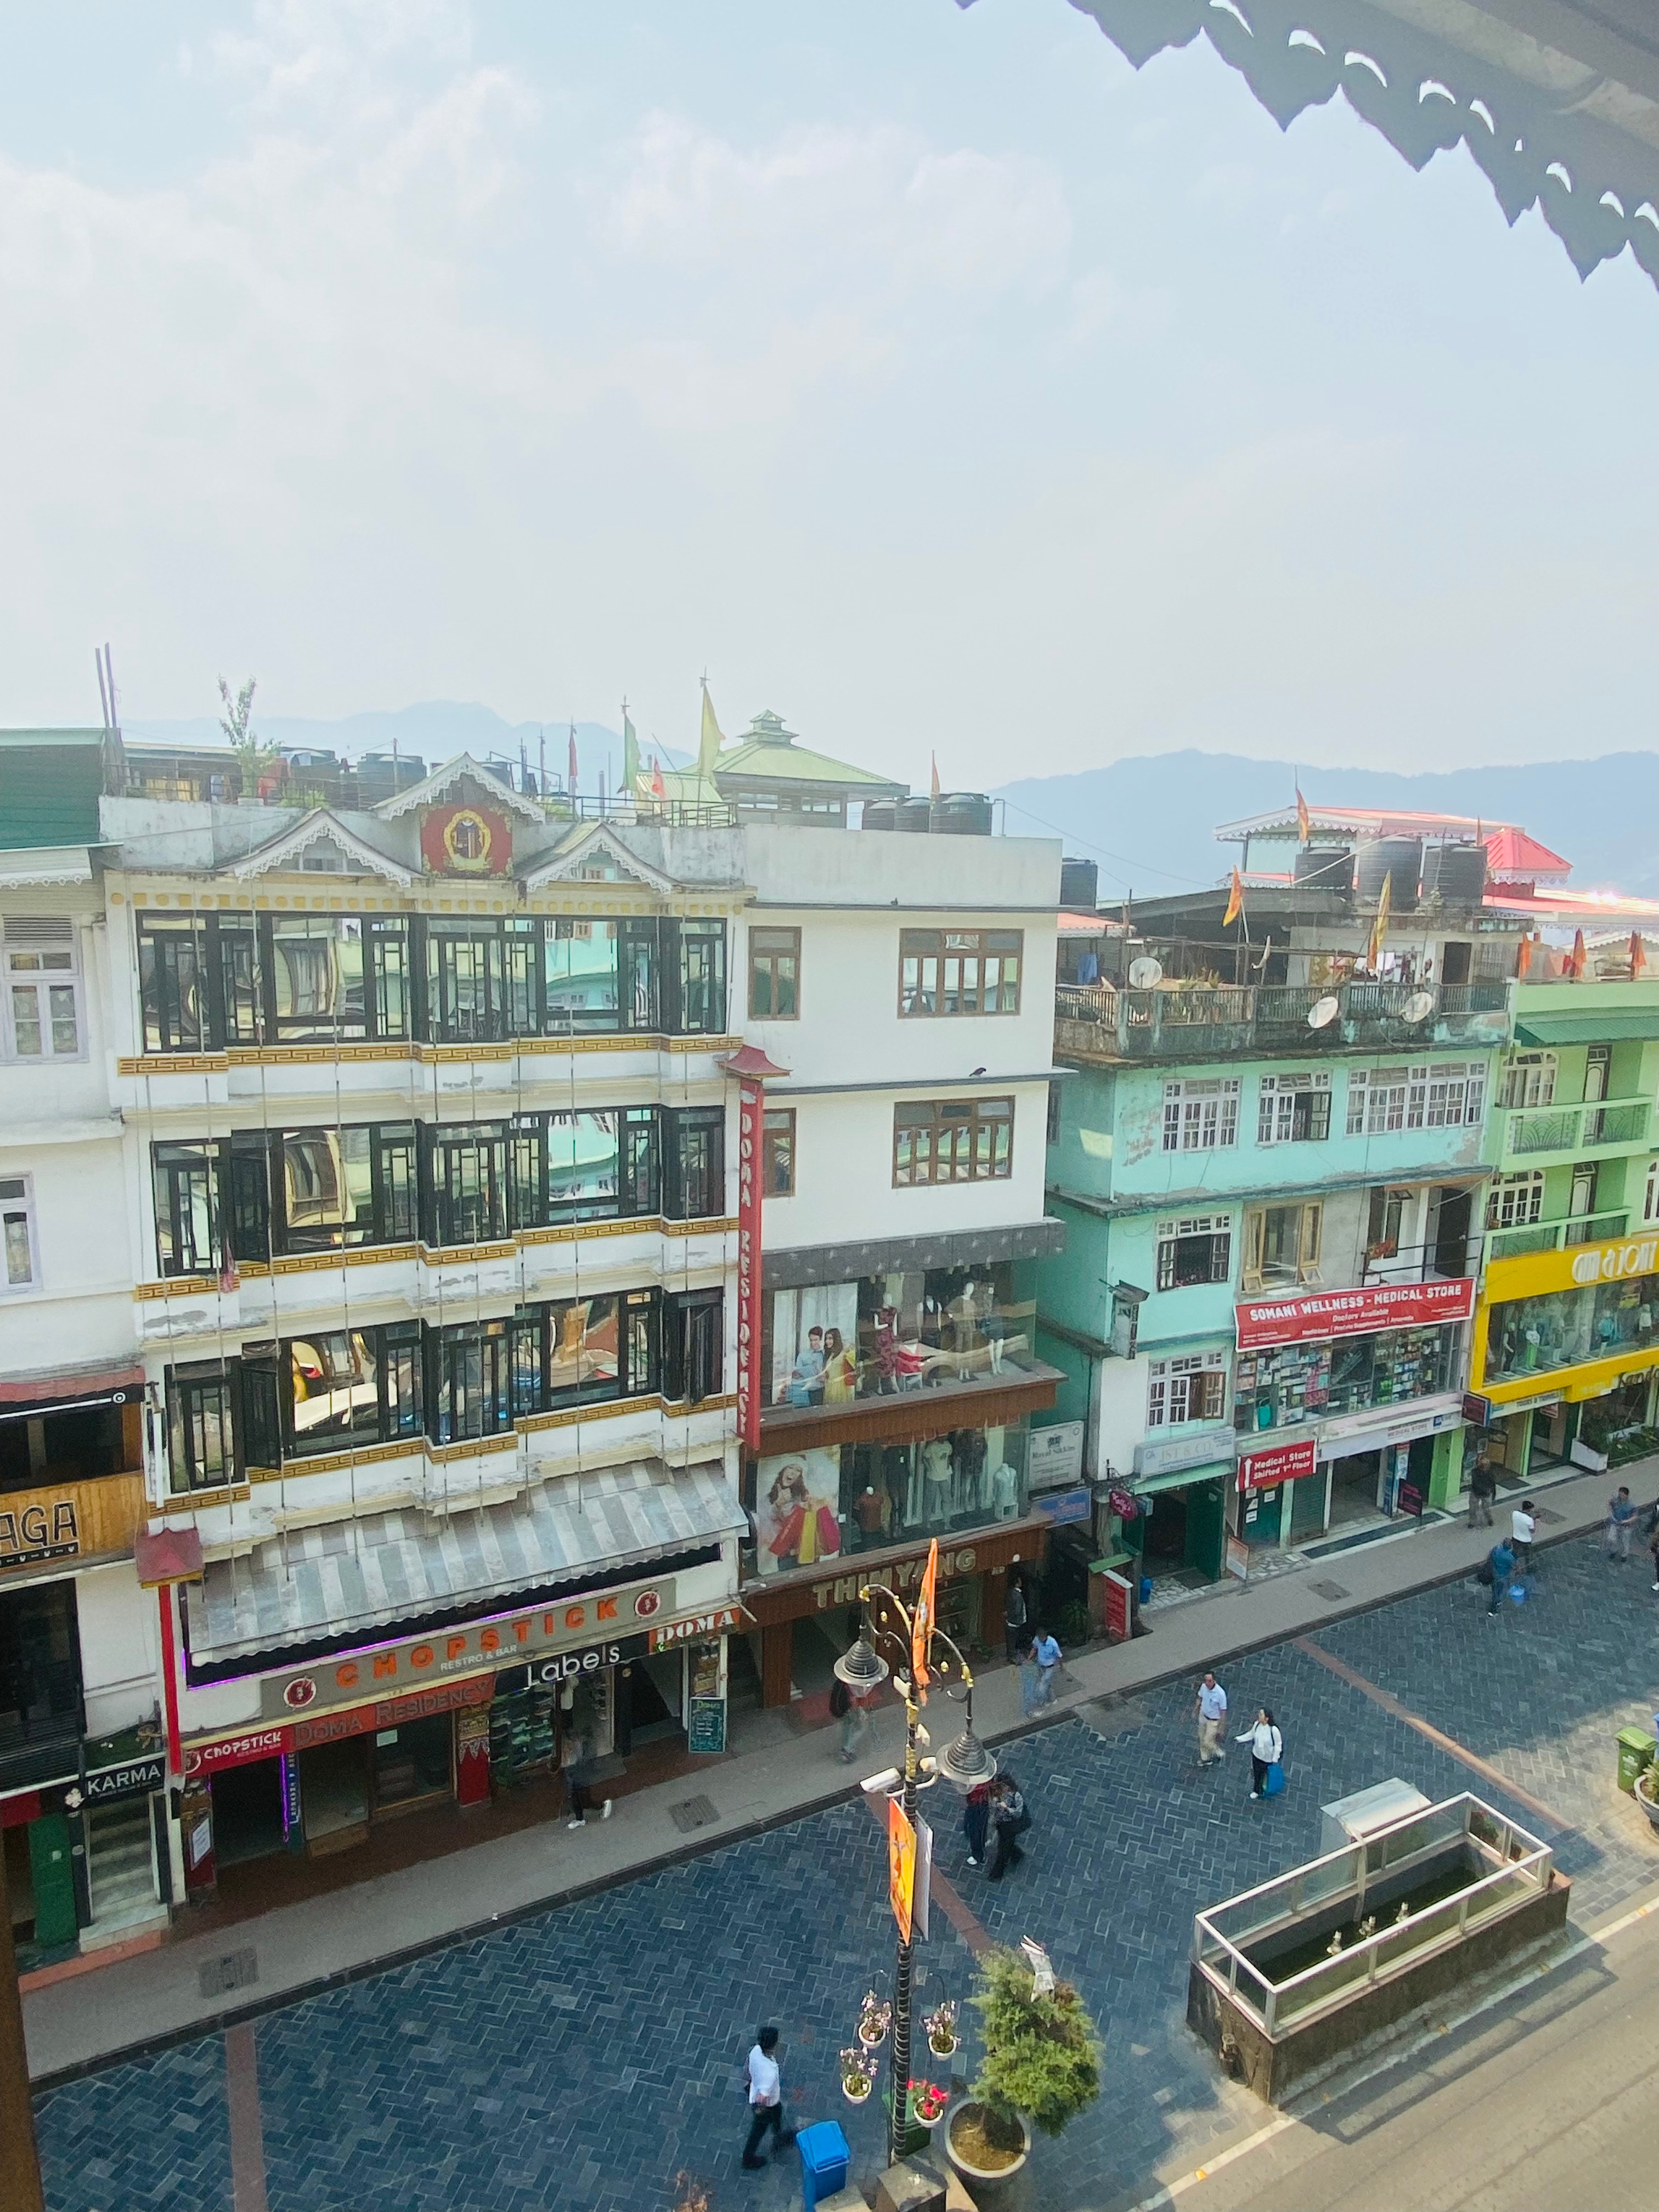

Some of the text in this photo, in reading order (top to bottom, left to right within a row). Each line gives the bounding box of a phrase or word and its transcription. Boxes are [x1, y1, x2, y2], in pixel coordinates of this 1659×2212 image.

[1250, 1304, 1297, 1321] SOMANI
[1300, 1296, 1364, 1314] WELLNESS
[1374, 1289, 1423, 1305] MEDICAL
[1426, 1284, 1462, 1298] STORE
[1254, 1451, 1311, 1470] Medical Store
[1254, 1467, 1280, 1480] Shifted
[1292, 1461, 1311, 1470] Floor
[335, 1596, 618, 1688] CHOPSTICK
[657, 1610, 734, 1644] DOMA
[440, 1653, 483, 1672] RESTRO
[495, 1645, 517, 1658] BAR
[527, 1642, 620, 1687] Labels
[87, 1764, 161, 1795] KARMA
